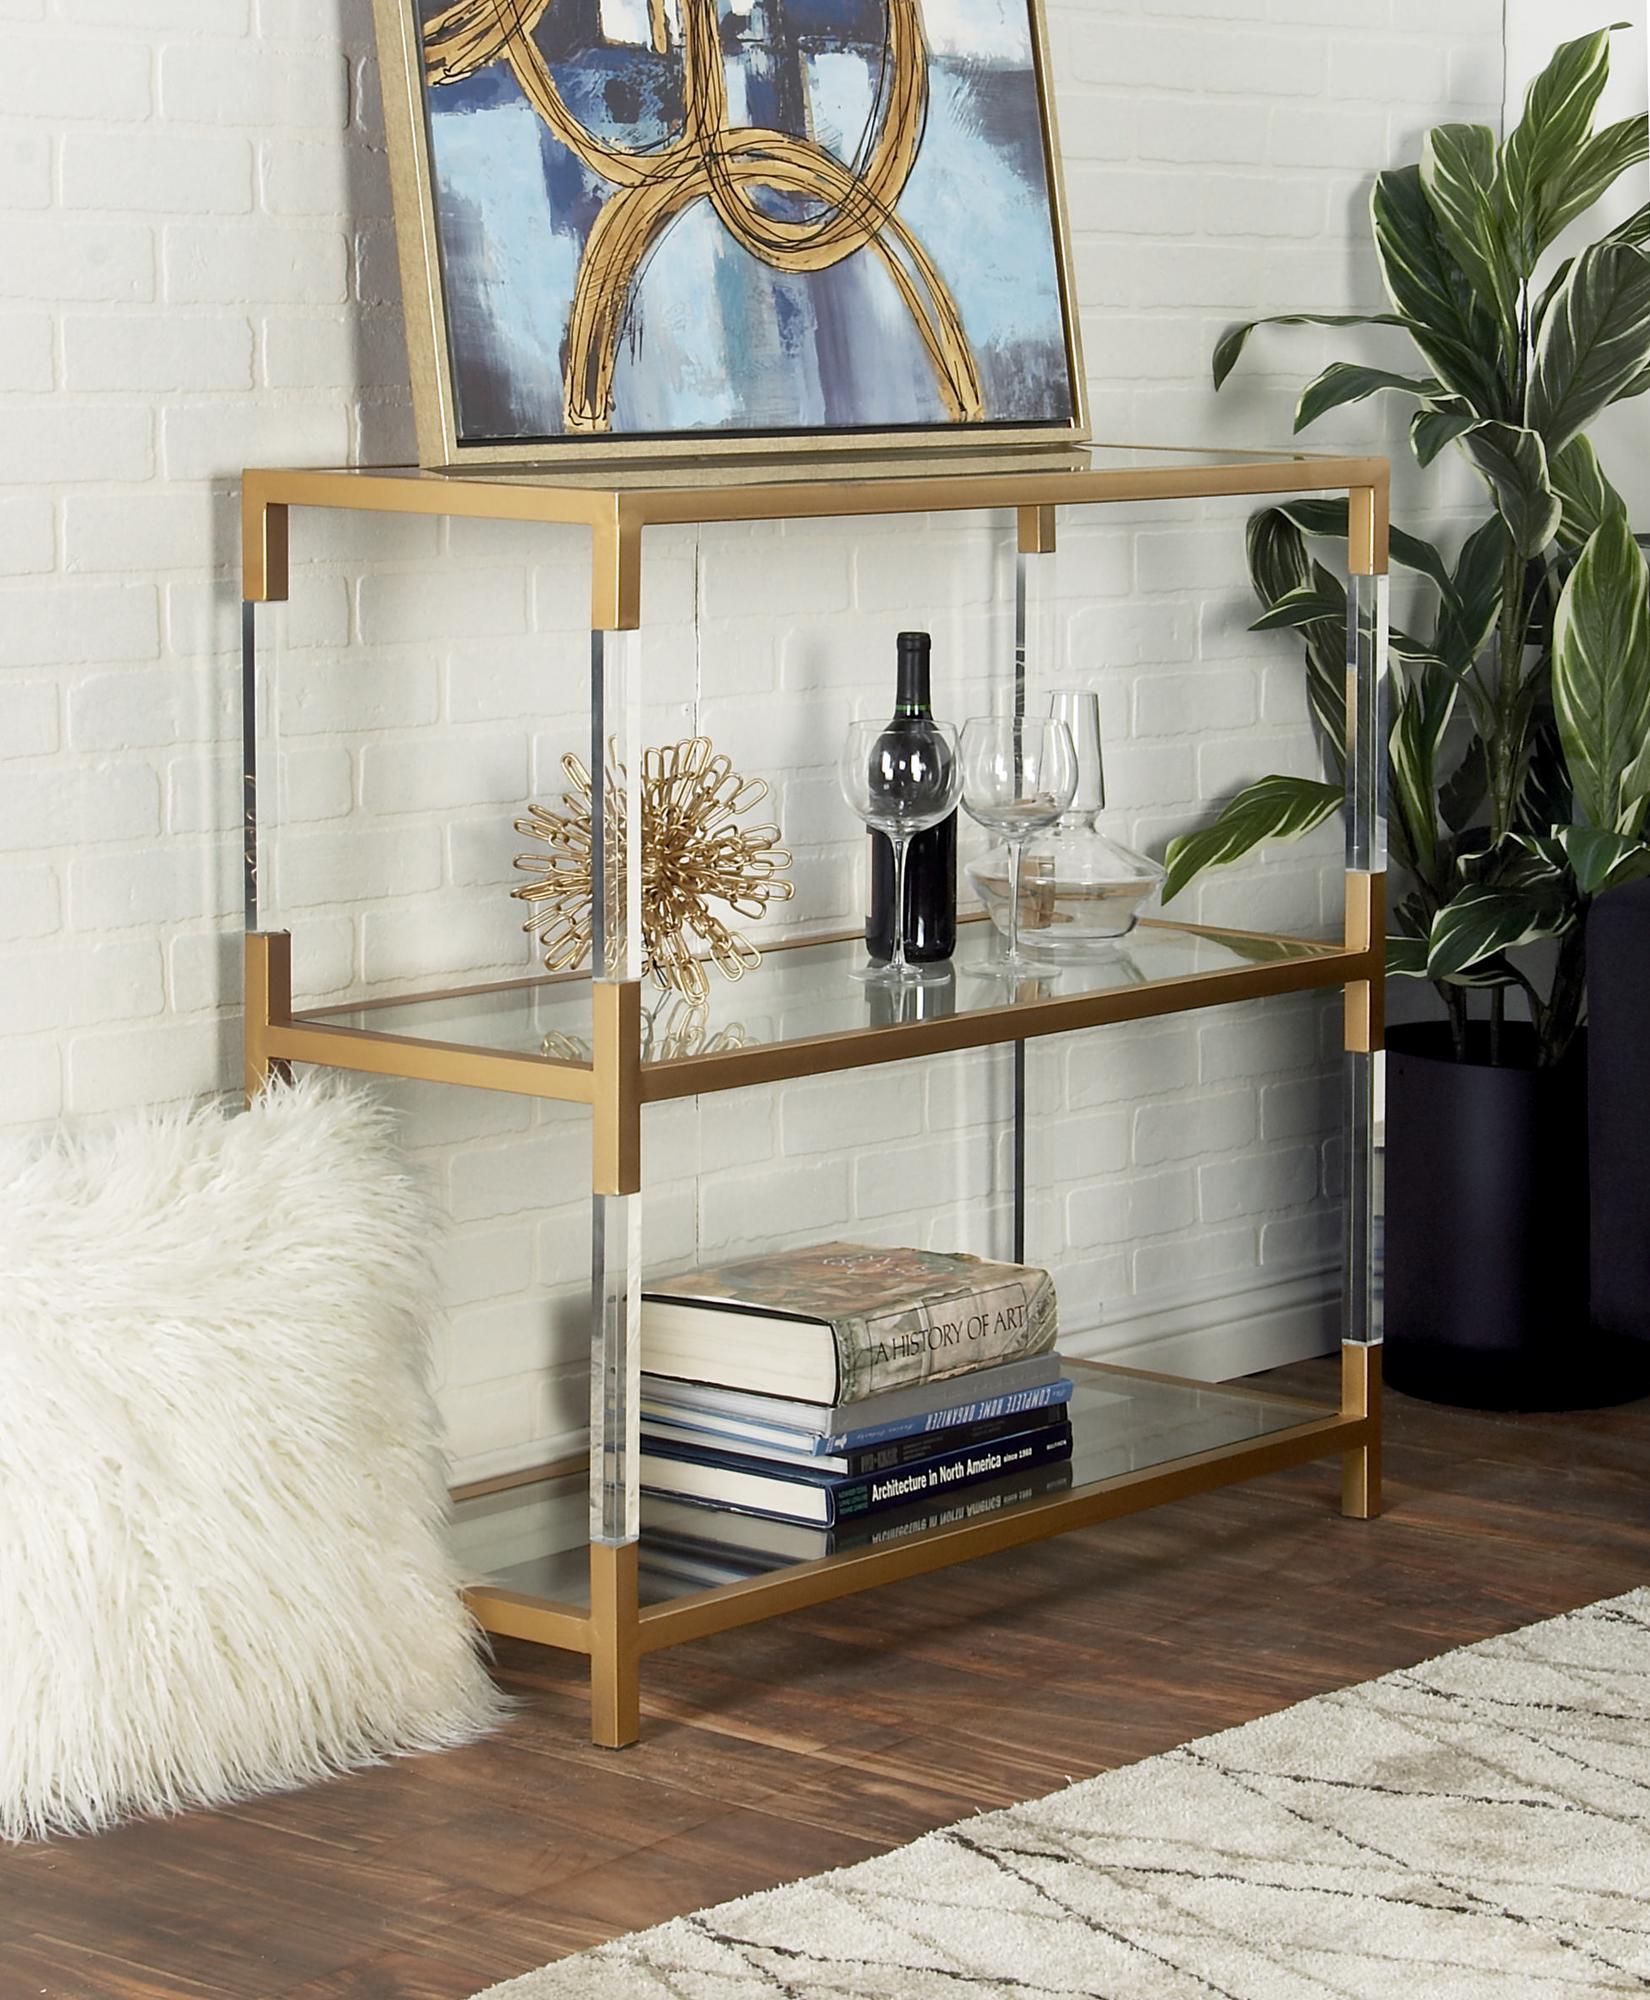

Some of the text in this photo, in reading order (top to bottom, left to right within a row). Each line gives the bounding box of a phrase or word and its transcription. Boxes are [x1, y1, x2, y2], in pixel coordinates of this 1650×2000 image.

[874, 1304, 1026, 1365] A HISTORY OF ART
[979, 1398, 1003, 1419] HOME
[1006, 1388, 1051, 1413] COMPLETE
[924, 1404, 976, 1431] ORGANIZER
[871, 1474, 927, 1502] Architecture
[928, 1469, 938, 1486] in
[939, 1461, 964, 1483] North
[966, 1453, 1002, 1476] America
[1003, 1452, 1018, 1463] since
